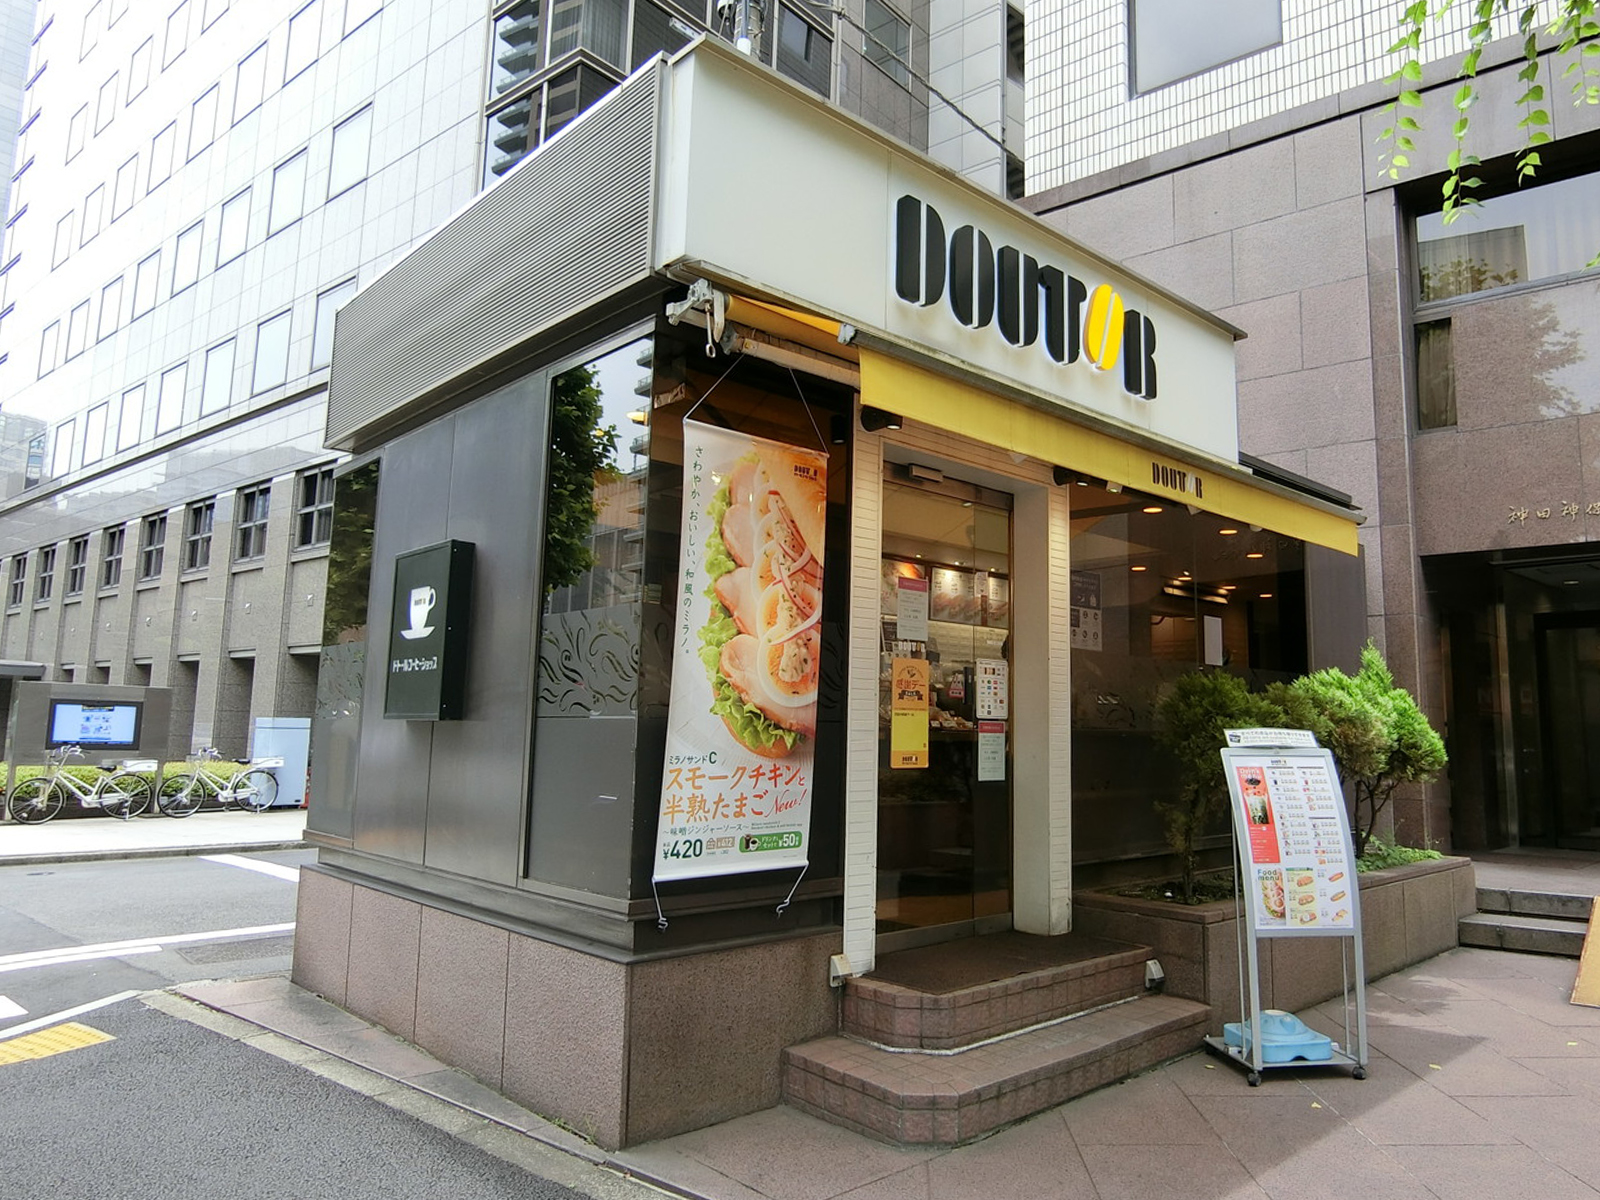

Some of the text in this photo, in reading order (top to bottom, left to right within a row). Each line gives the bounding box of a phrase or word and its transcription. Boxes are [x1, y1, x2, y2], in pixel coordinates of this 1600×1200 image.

[895, 194, 1158, 401] DOUTOR
[1151, 461, 1203, 499] DOUTOR
[665, 763, 806, 791] スモークチキンと
[663, 788, 808, 825] 半熟たまご New!
[663, 838, 703, 860] ¥420
